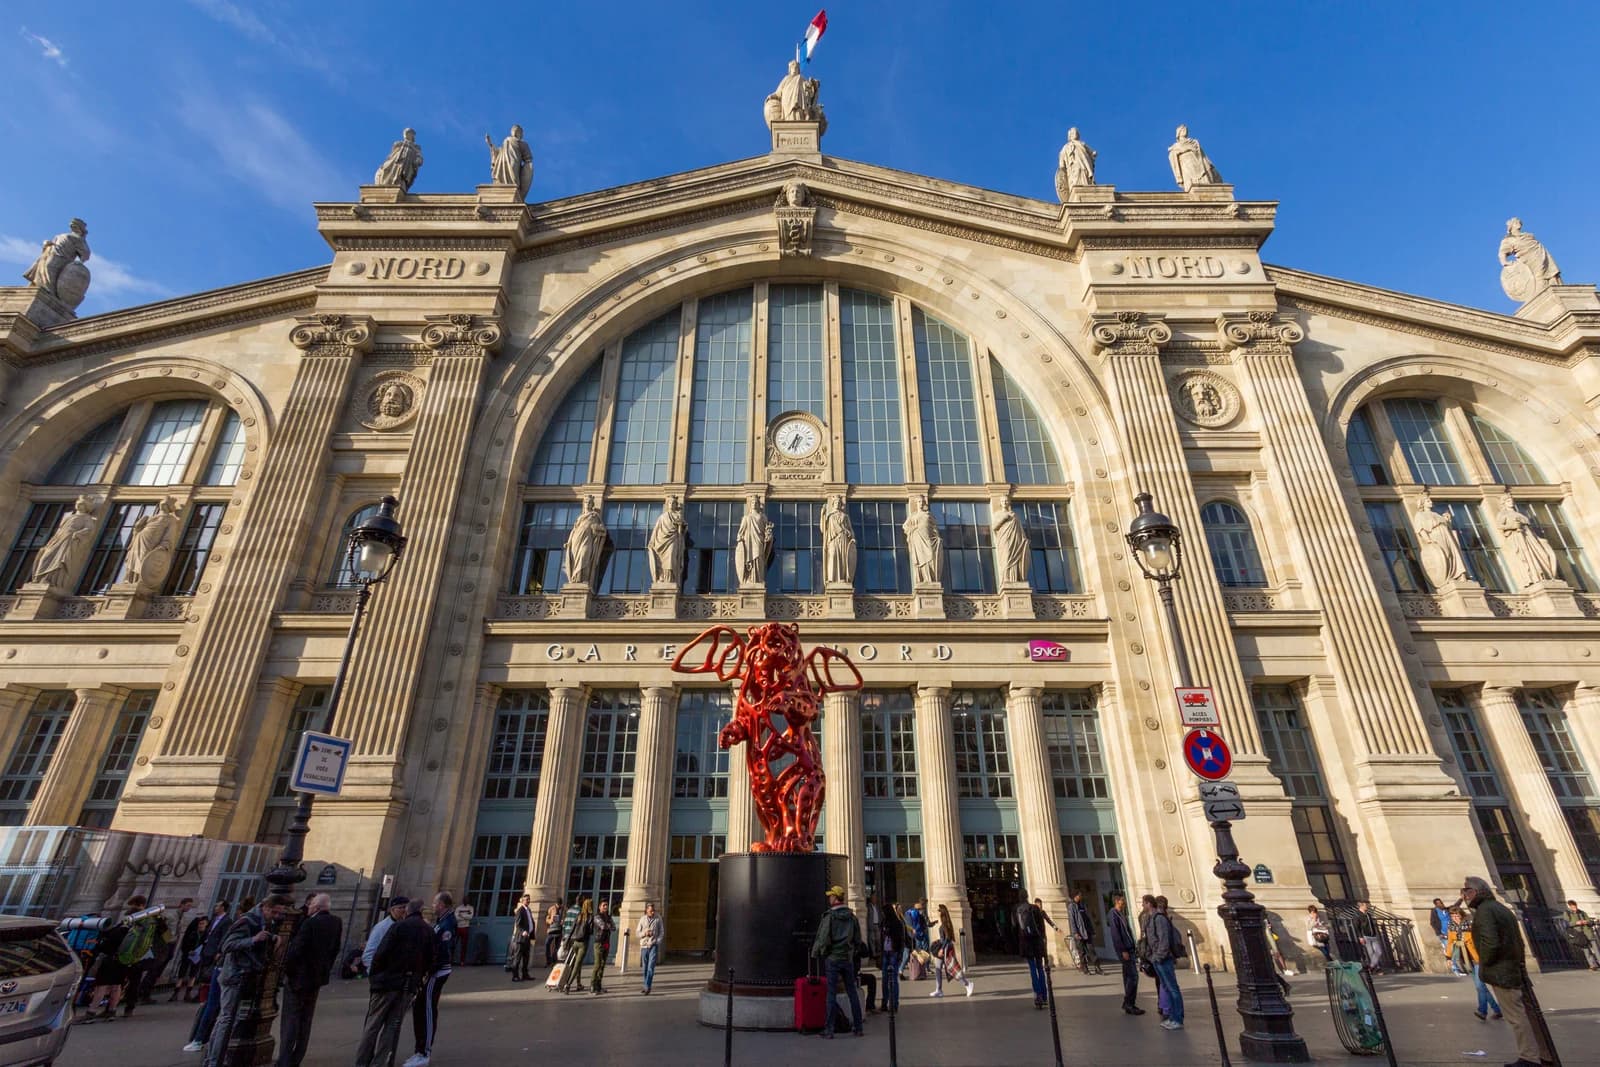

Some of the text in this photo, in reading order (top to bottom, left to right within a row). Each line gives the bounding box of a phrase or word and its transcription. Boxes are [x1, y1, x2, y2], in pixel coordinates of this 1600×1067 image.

[780, 136, 809, 145] PARIS
[366, 257, 465, 280] NORD
[1126, 256, 1224, 279] NORD
[546, 643, 676, 661] GARE
[1032, 646, 1065, 657] SNCF
